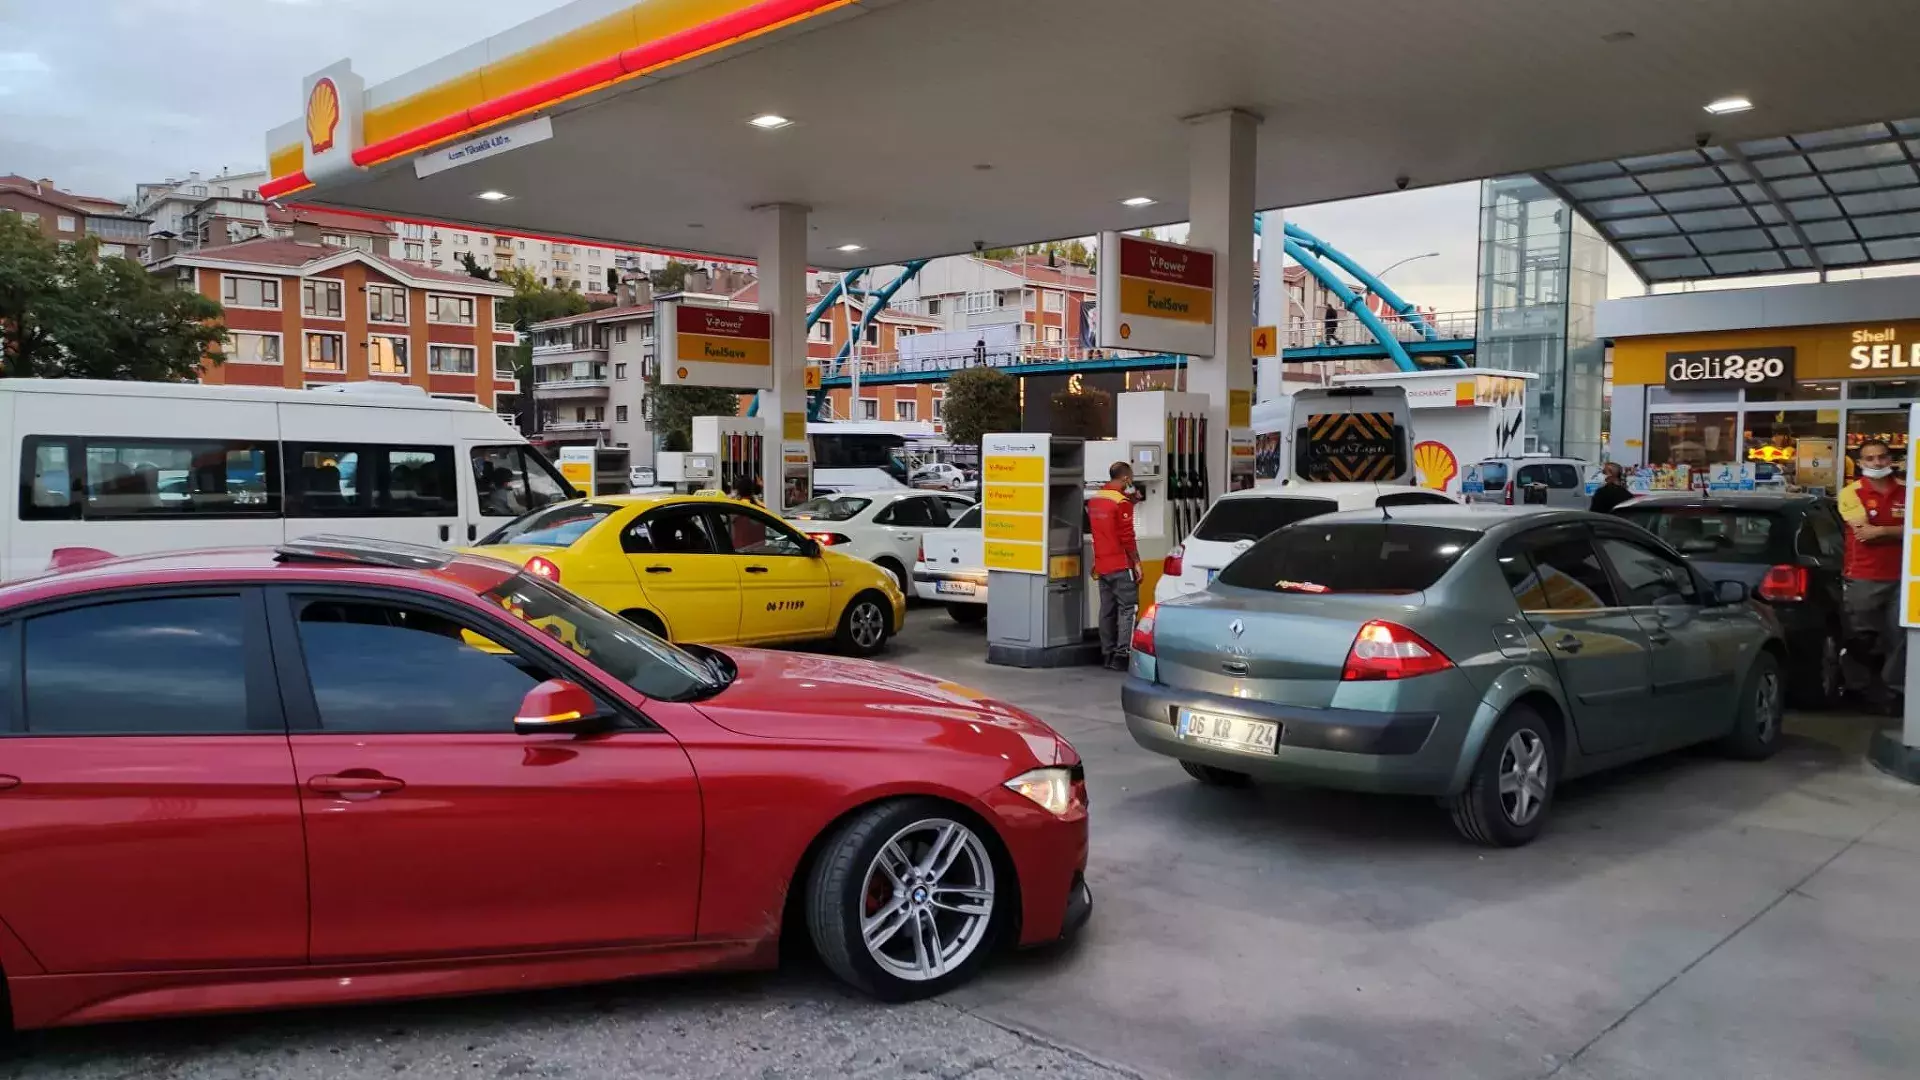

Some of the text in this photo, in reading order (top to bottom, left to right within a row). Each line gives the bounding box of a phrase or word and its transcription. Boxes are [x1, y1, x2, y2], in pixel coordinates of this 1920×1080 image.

[1150, 256, 1186, 272] V-Power
[1147, 295, 1188, 312] FuelSave
[706, 317, 742, 329] V-Power
[1256, 332, 1267, 350] 4
[1852, 328, 1895, 343] Shell
[705, 346, 746, 358] FuelSave
[1669, 354, 1784, 383] deli2go
[806, 371, 813, 384] 2
[766, 601, 777, 611] 06
[1188, 714, 1274, 745] 06 KR 724
